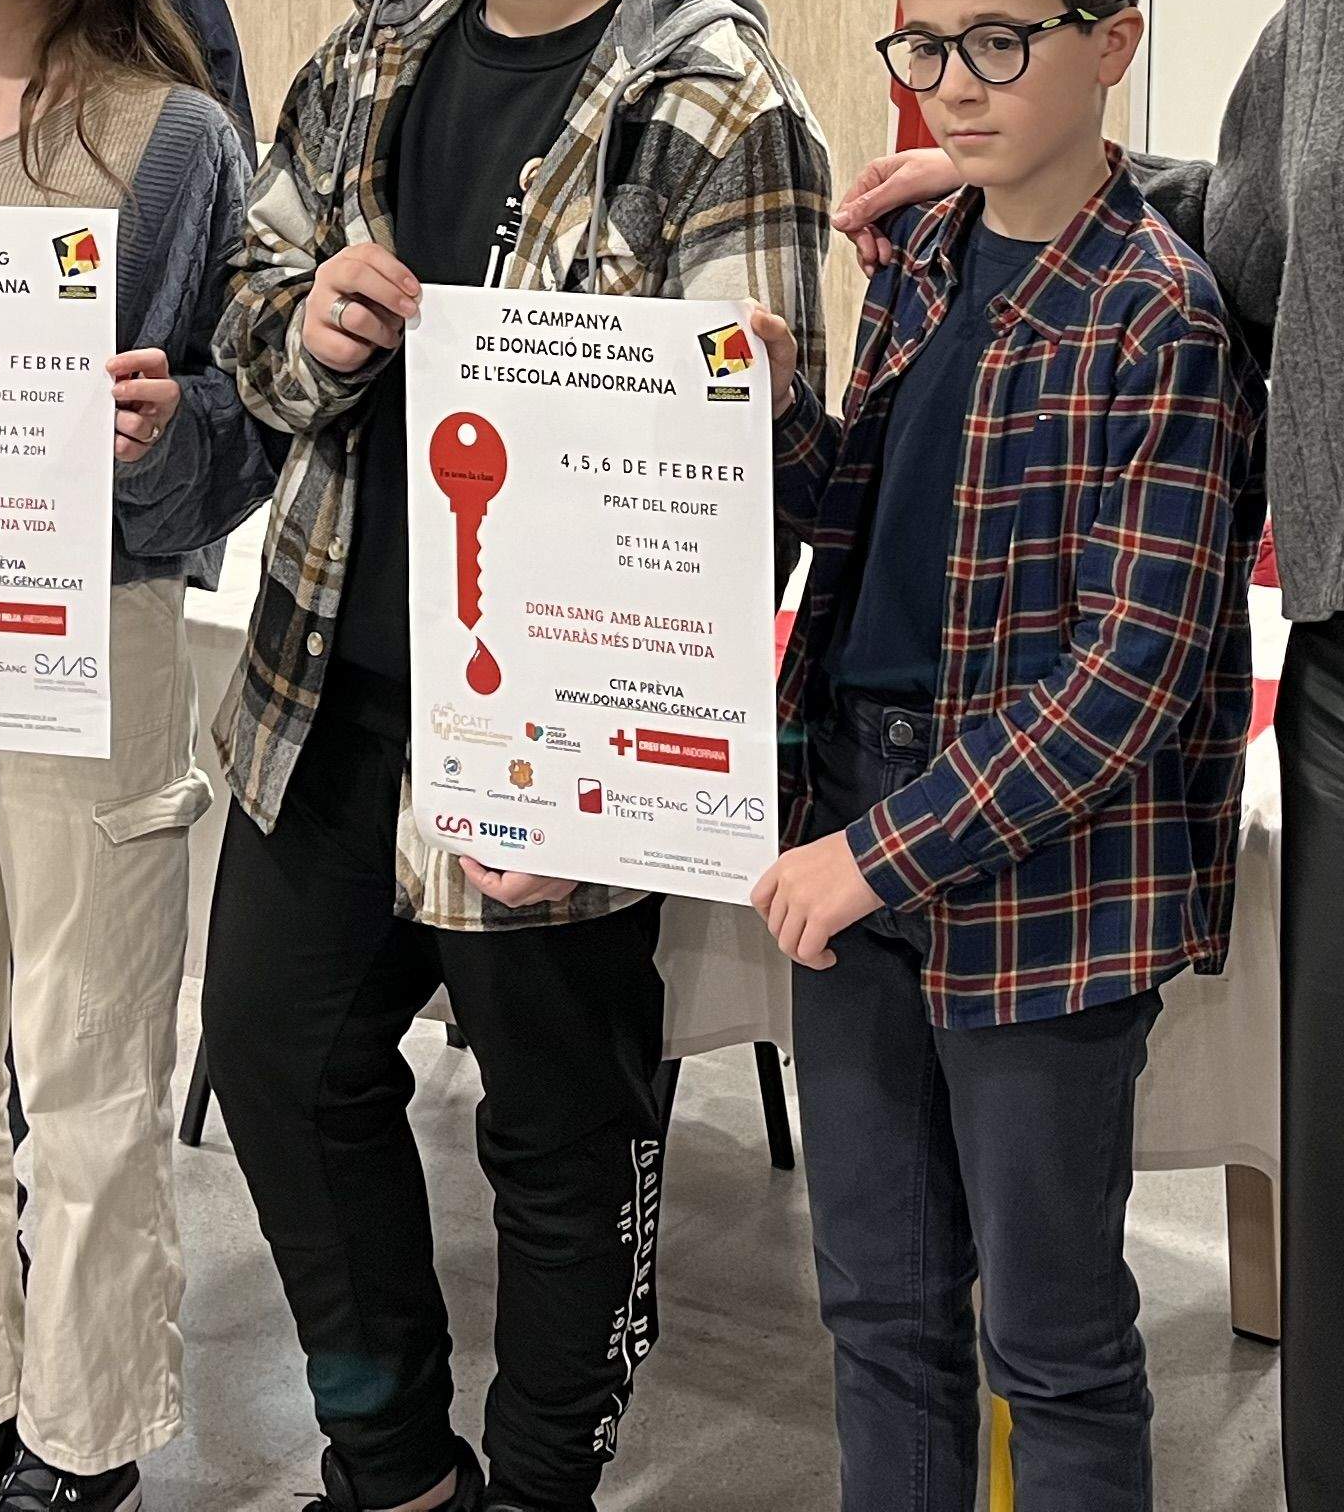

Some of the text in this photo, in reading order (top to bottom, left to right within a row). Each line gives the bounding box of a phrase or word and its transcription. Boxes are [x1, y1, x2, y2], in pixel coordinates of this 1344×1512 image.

[501, 309, 622, 331] 7A CAMPANYA
[476, 336, 654, 363] DE DONACIÓ DE SANG
[10, 356, 90, 370] FEBRER
[460, 365, 676, 395] DE L'ESCOLA ANDORRANA
[20, 390, 64, 403] ROURE
[10, 426, 18, 436] A
[23, 426, 45, 437] 14H
[11, 444, 20, 455] A
[23, 444, 46, 456] 20H
[623, 459, 647, 475] DE
[659, 462, 745, 482] FEBRER
[604, 496, 718, 516] PRAT DEL ROURE
[23, 518, 56, 533] VIDA
[616, 535, 698, 553] DE 11H A 14H
[618, 556, 700, 573] DE 16H A 20H
[526, 602, 564, 617] DONA
[568, 606, 604, 622] SANG
[610, 612, 640, 626] AMB
[644, 616, 705, 633] ALEGRIA
[528, 626, 714, 659] SALVARÀS MÉS D'UNA VIDA
[609, 679, 683, 698] CITA PRÈVIA
[555, 689, 746, 723] WWW.DONARSANG.GENCAT.CAT
[607, 790, 688, 812] BANC DE SANG
[613, 805, 654, 822] TEIXITS
[479, 822, 527, 842] SUPER
